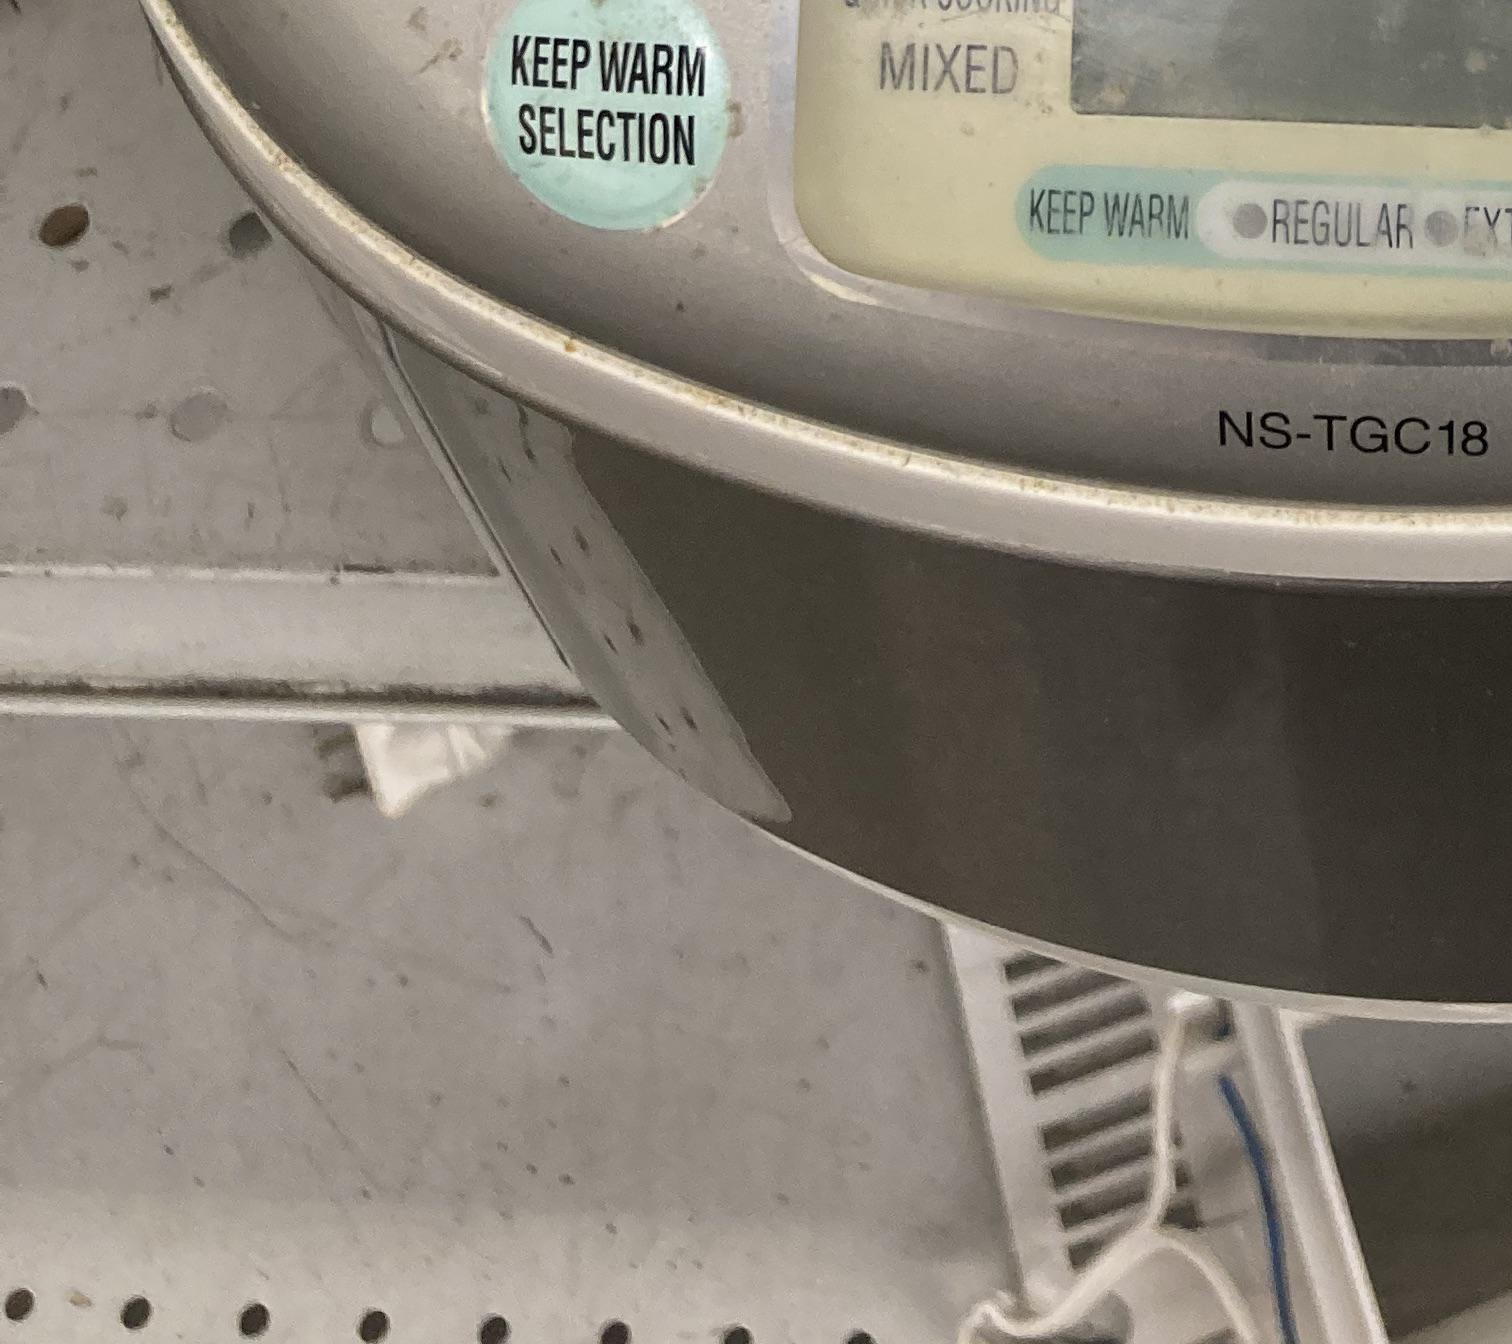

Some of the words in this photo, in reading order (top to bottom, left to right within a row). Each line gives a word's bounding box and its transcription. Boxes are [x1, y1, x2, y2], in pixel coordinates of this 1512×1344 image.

[510, 34, 591, 92] KEEP
[599, 39, 706, 97] WARM
[879, 41, 1019, 95] MIXED
[518, 105, 695, 166] SELECTION
[1029, 187, 1094, 237] KEEP
[1103, 192, 1190, 240] WARM
[1271, 198, 1414, 249] REGULAR
[1218, 410, 1489, 457] NS-TGC18
